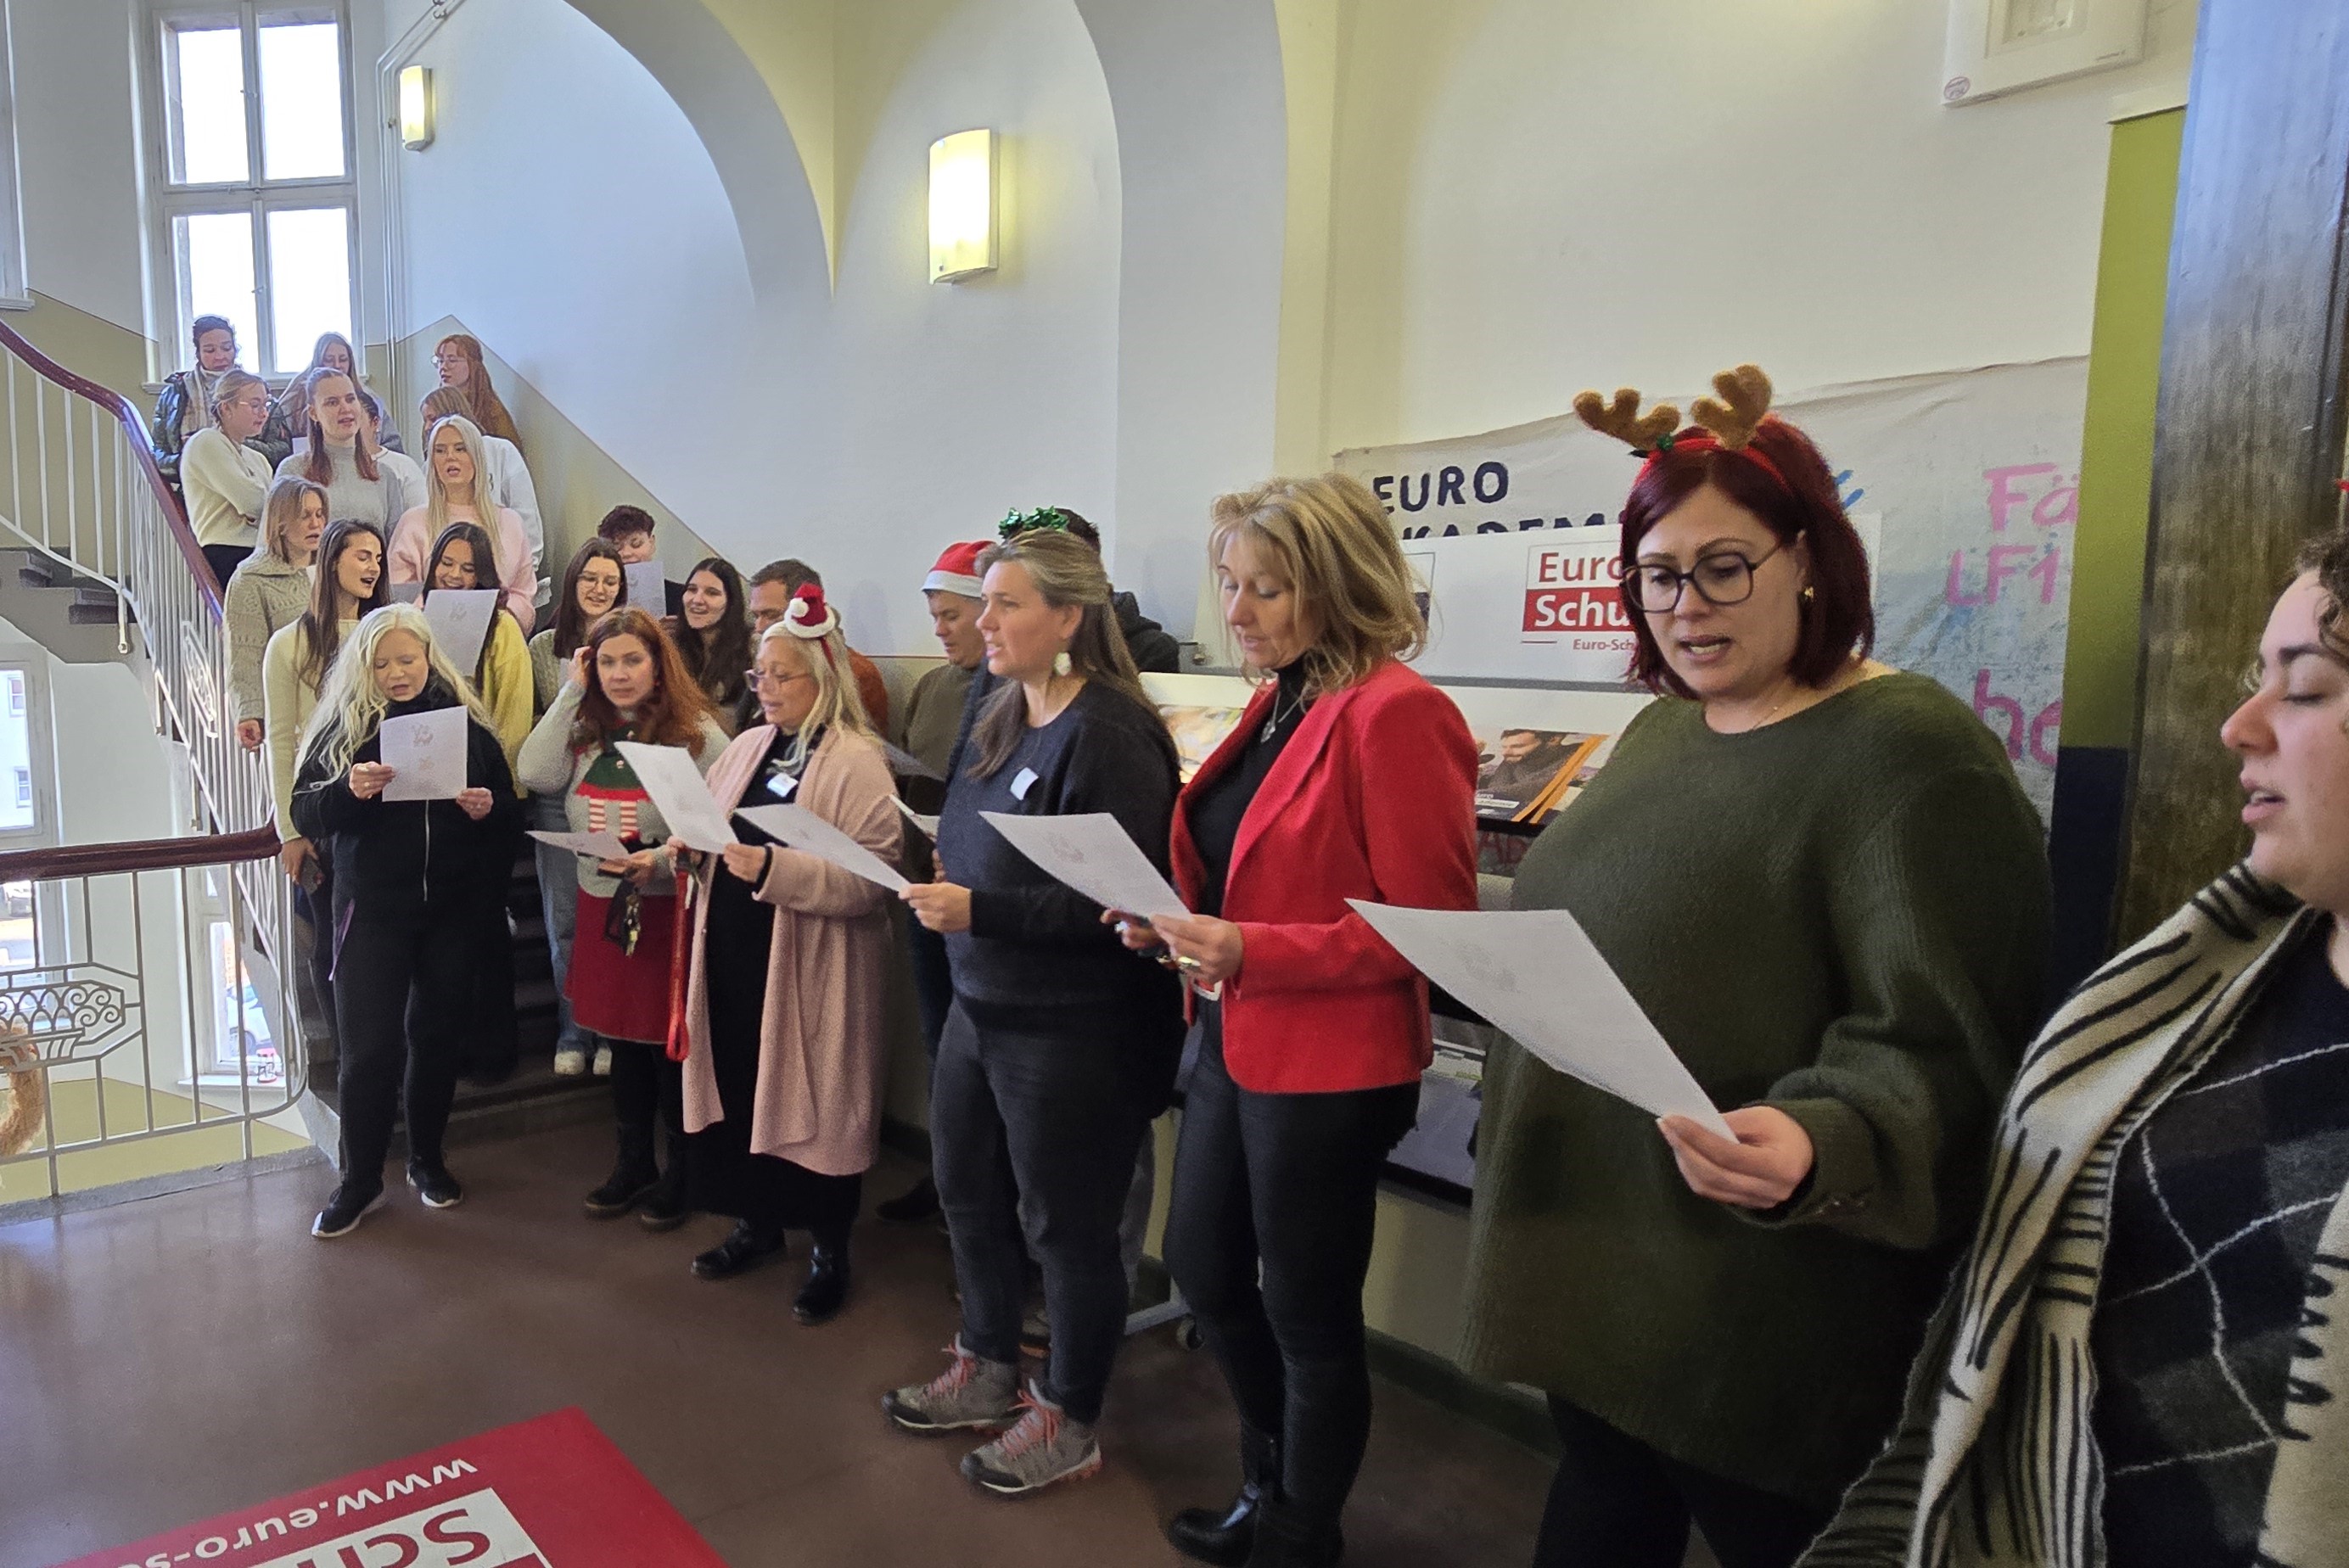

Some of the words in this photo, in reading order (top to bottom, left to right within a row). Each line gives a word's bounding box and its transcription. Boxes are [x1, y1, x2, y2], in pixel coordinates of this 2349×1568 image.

[1372, 461, 1509, 515] EURO
[1946, 545, 2062, 605] LF1
[117, 1459, 478, 1568] www.euro-s
